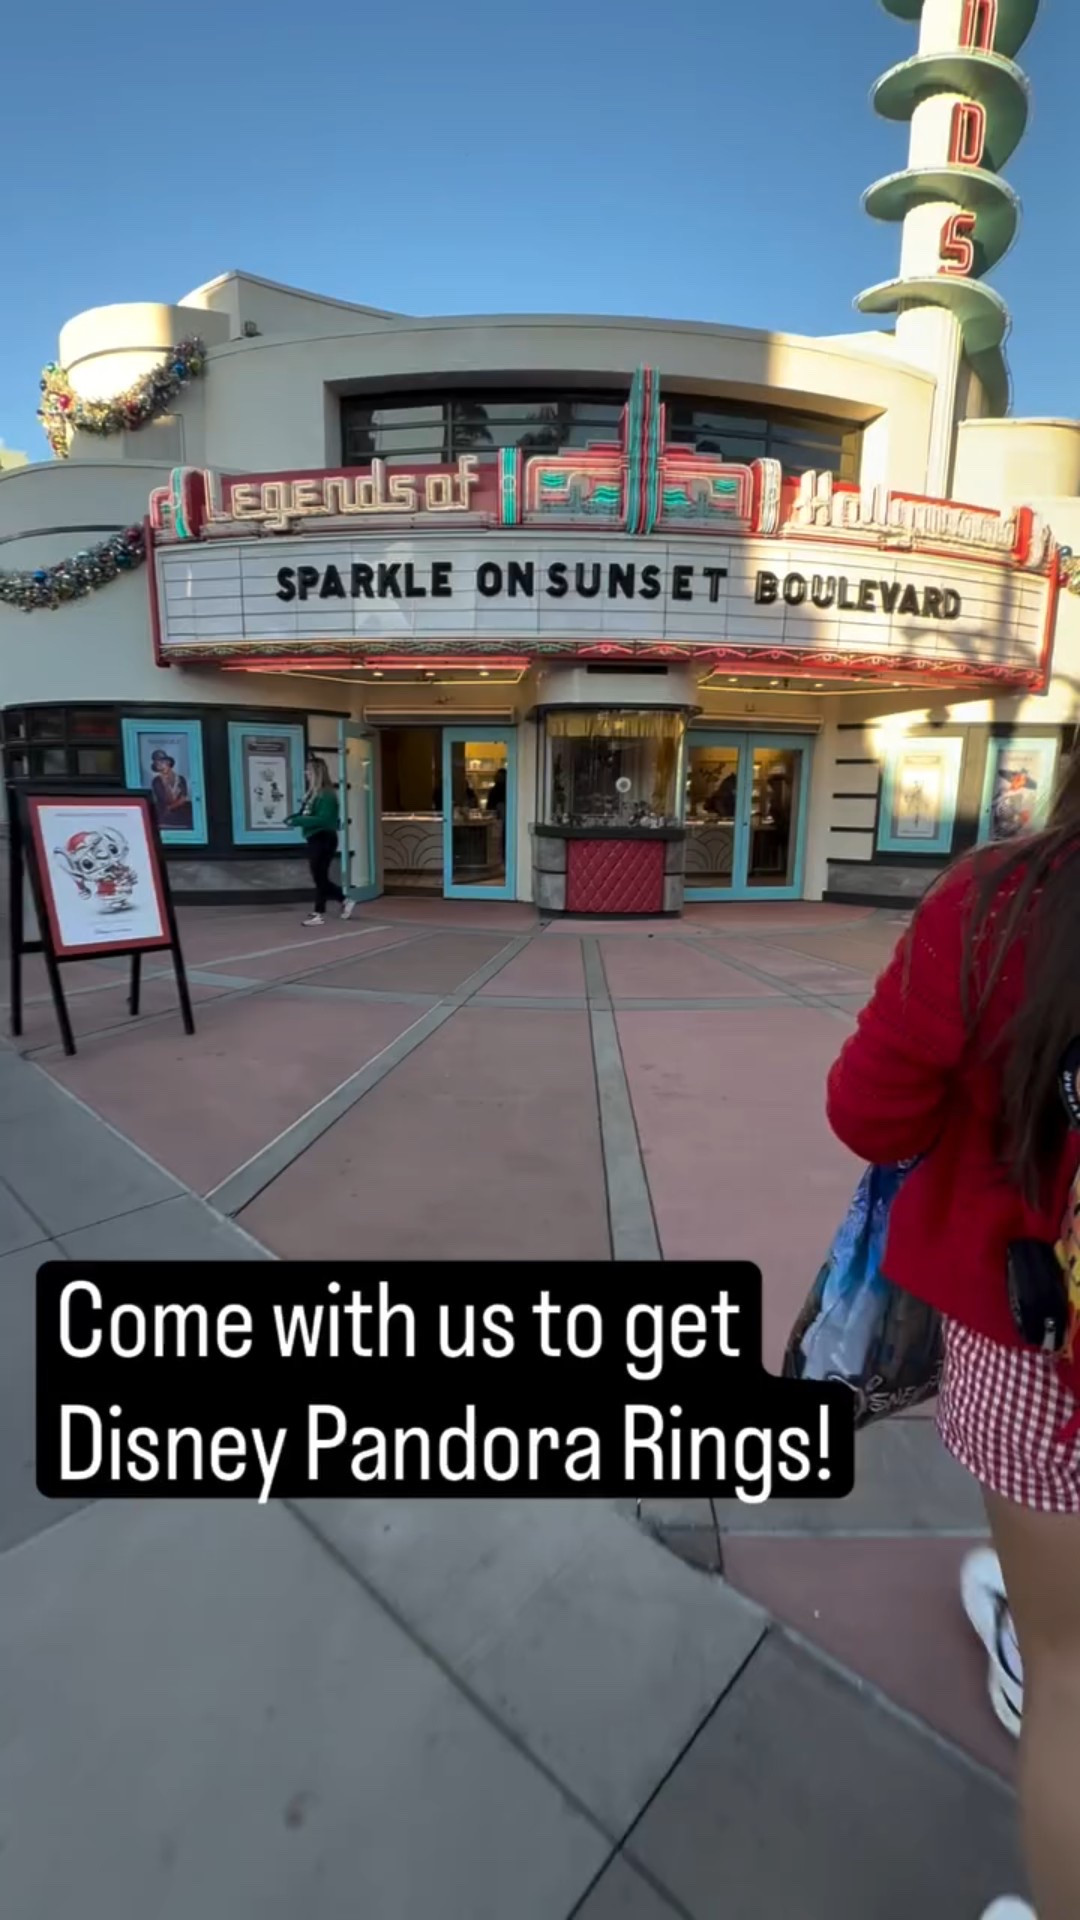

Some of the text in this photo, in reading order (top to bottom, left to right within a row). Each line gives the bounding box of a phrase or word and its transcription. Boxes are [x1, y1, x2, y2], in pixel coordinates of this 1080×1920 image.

[203, 457, 419, 531] Legends
[425, 455, 479, 513] of
[276, 561, 962, 620] SPARKLE ON SUNSET BOULEVARD
